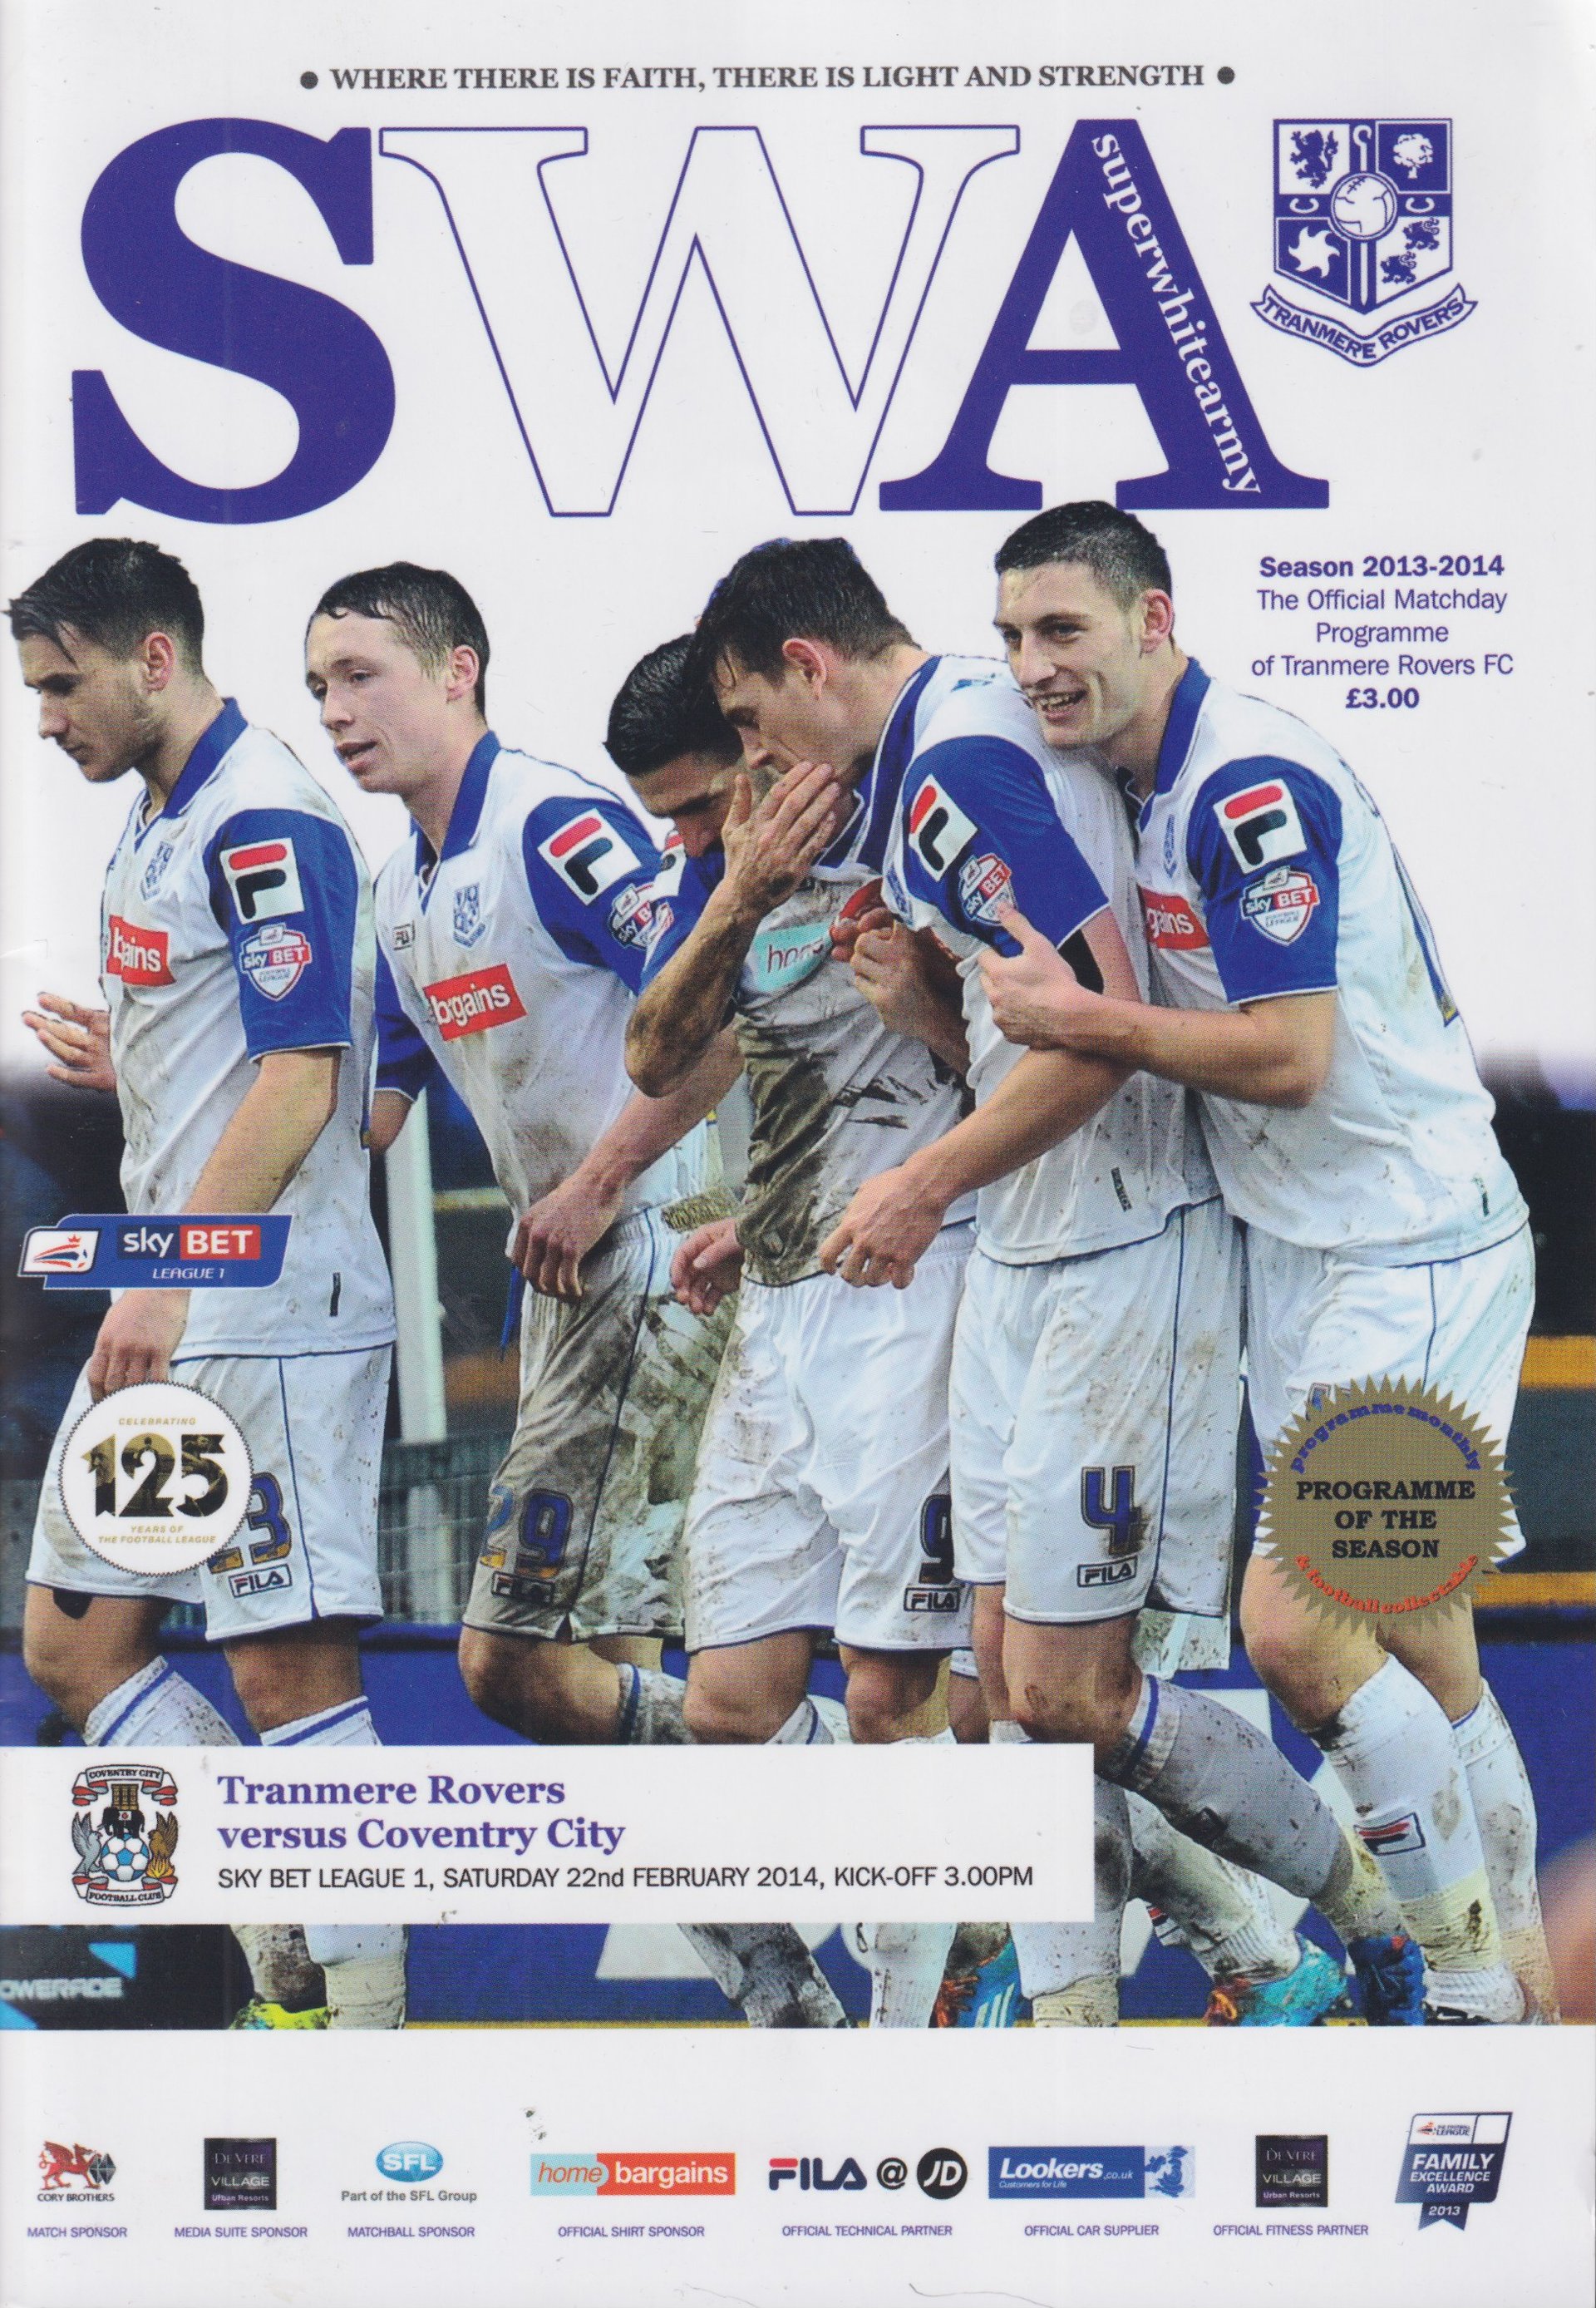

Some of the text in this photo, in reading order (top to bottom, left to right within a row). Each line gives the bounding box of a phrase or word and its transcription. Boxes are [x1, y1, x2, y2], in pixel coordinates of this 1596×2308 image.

[331, 66, 1204, 92] WHERE THERE IS FAITH, THERE IS LIGHT AND STRENGTH
[72, 117, 1329, 524] SWA
[1091, 134, 1262, 494] superwhitearmy
[1263, 295, 1465, 359] TRANMERE ROVERS
[1260, 555, 1505, 577] Season 2013-2014
[1257, 589, 1507, 616] The Official Matchday
[1317, 622, 1449, 648] Programme
[1252, 653, 1513, 677] of Tranmere Rovers FC
[1346, 688, 1419, 709] £3.00
[1278, 889, 1312, 907] BET
[272, 946, 305, 964] BET
[124, 1227, 253, 1256] sky BET
[153, 1267, 225, 1279] LEAGUE 1
[119, 1417, 196, 1426] CELEBRATING
[81, 1433, 229, 1517] 125
[1296, 1480, 1476, 1500] PROGRAMME
[1081, 1465, 1141, 1556] 4
[1334, 1510, 1437, 1529] OF THE
[131, 1525, 184, 1533] YEARS OF
[98, 1536, 216, 1544] THE FOOTBALL LEAGUE
[1332, 1539, 1440, 1558] SEASON
[1085, 1562, 1132, 1584] FILA
[234, 1571, 284, 1594] FILA
[1306, 1569, 1380, 1613] football
[911, 1592, 954, 1610] FILA
[89, 1769, 160, 1778] COVENTRY CITY
[218, 1776, 564, 1805] Tranmere Rovers
[218, 1817, 625, 1856] versus Coventry City
[219, 1866, 1033, 1891] SKY BET LEAGUE 1, SATURDAY 22nd FEBRUARY 2014, KICK-OFF 3.00PM
[89, 1891, 161, 1902] FOOTBALL CLUB
[383, 2153, 436, 2171] SFL
[1413, 2153, 1495, 2170] FAMILY
[211, 2176, 270, 2187] VILLAGE
[538, 2160, 729, 2189] home bargains
[769, 2157, 908, 2191] FILA @
[924, 2160, 963, 2187] JD
[1263, 2173, 1322, 2184] VILLAGE
[1411, 2171, 1491, 2182] EXCELLENCE
[1052, 2180, 1067, 2188] Life
[1426, 2183, 1475, 2193] AWARD
[37, 2192, 115, 2202] CORY BROTHERS
[342, 2190, 477, 2204] Part of the SFL Group
[1429, 2206, 1461, 2217] 2013
[27, 2226, 127, 2238] MATCH SPONSOR
[175, 2226, 308, 2238] MEDIA SUITE SPONSOR
[347, 2226, 475, 2238] MATCHBALL SPONSOR
[558, 2226, 705, 2238] OFFICIAL SHIRT SPONSOR
[782, 2225, 953, 2236] OFFICIAL TECHNICAL PARTNER
[1024, 2225, 1159, 2236] OFFICIAL CAR SUPPLIER
[1214, 2225, 1368, 2236] OFFICIAL FITNESS PARTNER
